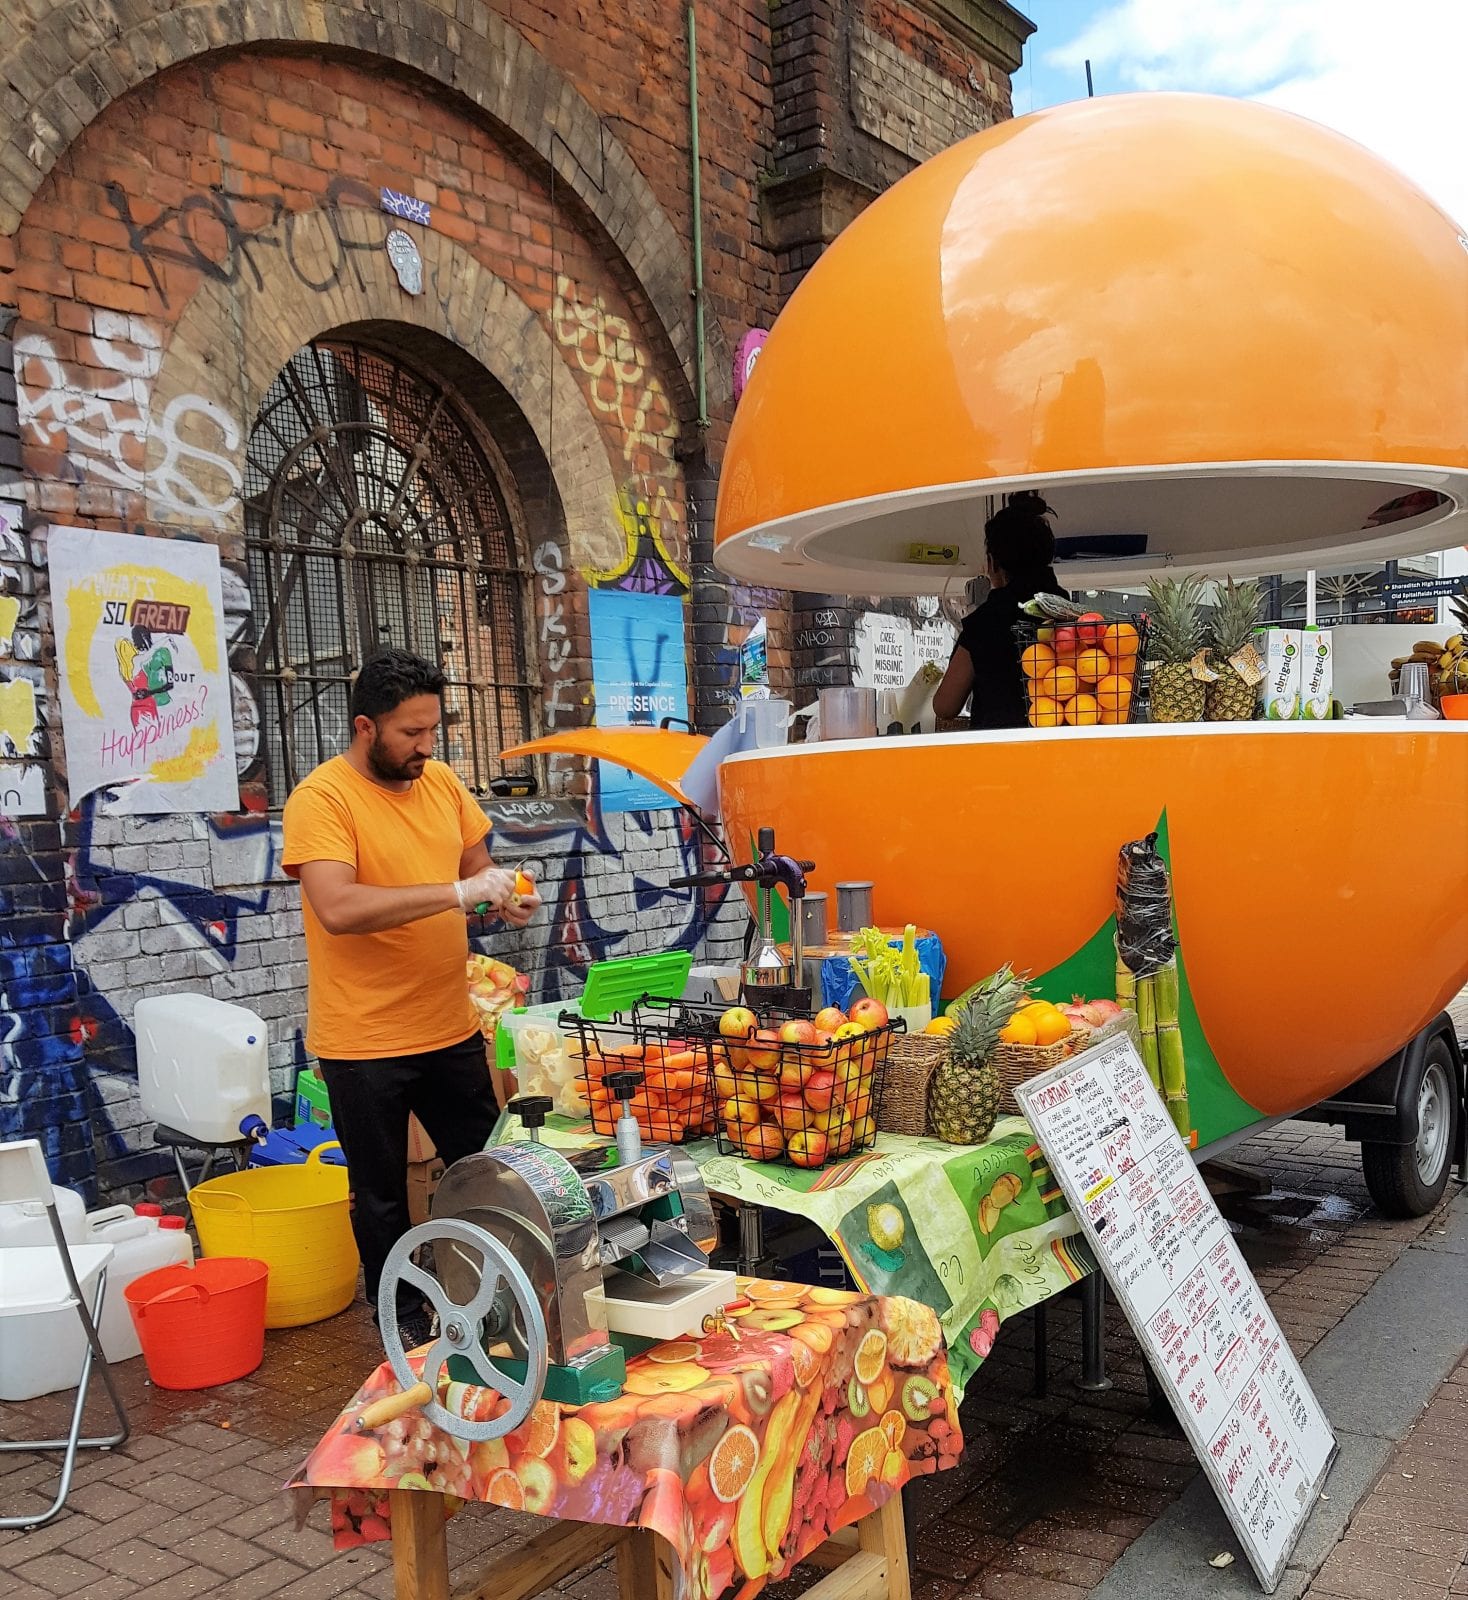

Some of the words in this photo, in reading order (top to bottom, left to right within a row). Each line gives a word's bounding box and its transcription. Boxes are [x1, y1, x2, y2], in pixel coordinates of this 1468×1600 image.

[1392, 582, 1420, 590] Shoreditch
[1403, 590, 1432, 598] Spitalfields
[103, 601, 127, 625] SO
[134, 604, 190, 631] GREAT
[918, 649, 926, 658] IS
[875, 659, 903, 673] MISSING
[157, 671, 196, 684] ABOUT
[873, 675, 905, 685] PRESUMED
[609, 695, 676, 712] PRESENCE
[101, 685, 208, 768] Happiness?
[1031, 1080, 1070, 1113] IMPORTANT
[1128, 1079, 1144, 1097] ADDED
[1130, 1095, 1147, 1114] SUGAR
[1104, 1144, 1117, 1166] No
[1113, 1128, 1131, 1151] Sugar
[1086, 1196, 1107, 1220] CARROT
[1104, 1186, 1119, 1204] JUICE
[1176, 1351, 1186, 1366] AND
[1189, 1389, 1198, 1403] ONE
[1195, 1378, 1205, 1393] SIZE
[1210, 1434, 1231, 1465] MEDIUM
[1222, 1459, 1242, 1493] LARGE
[1262, 1516, 1275, 1540] CARDS
